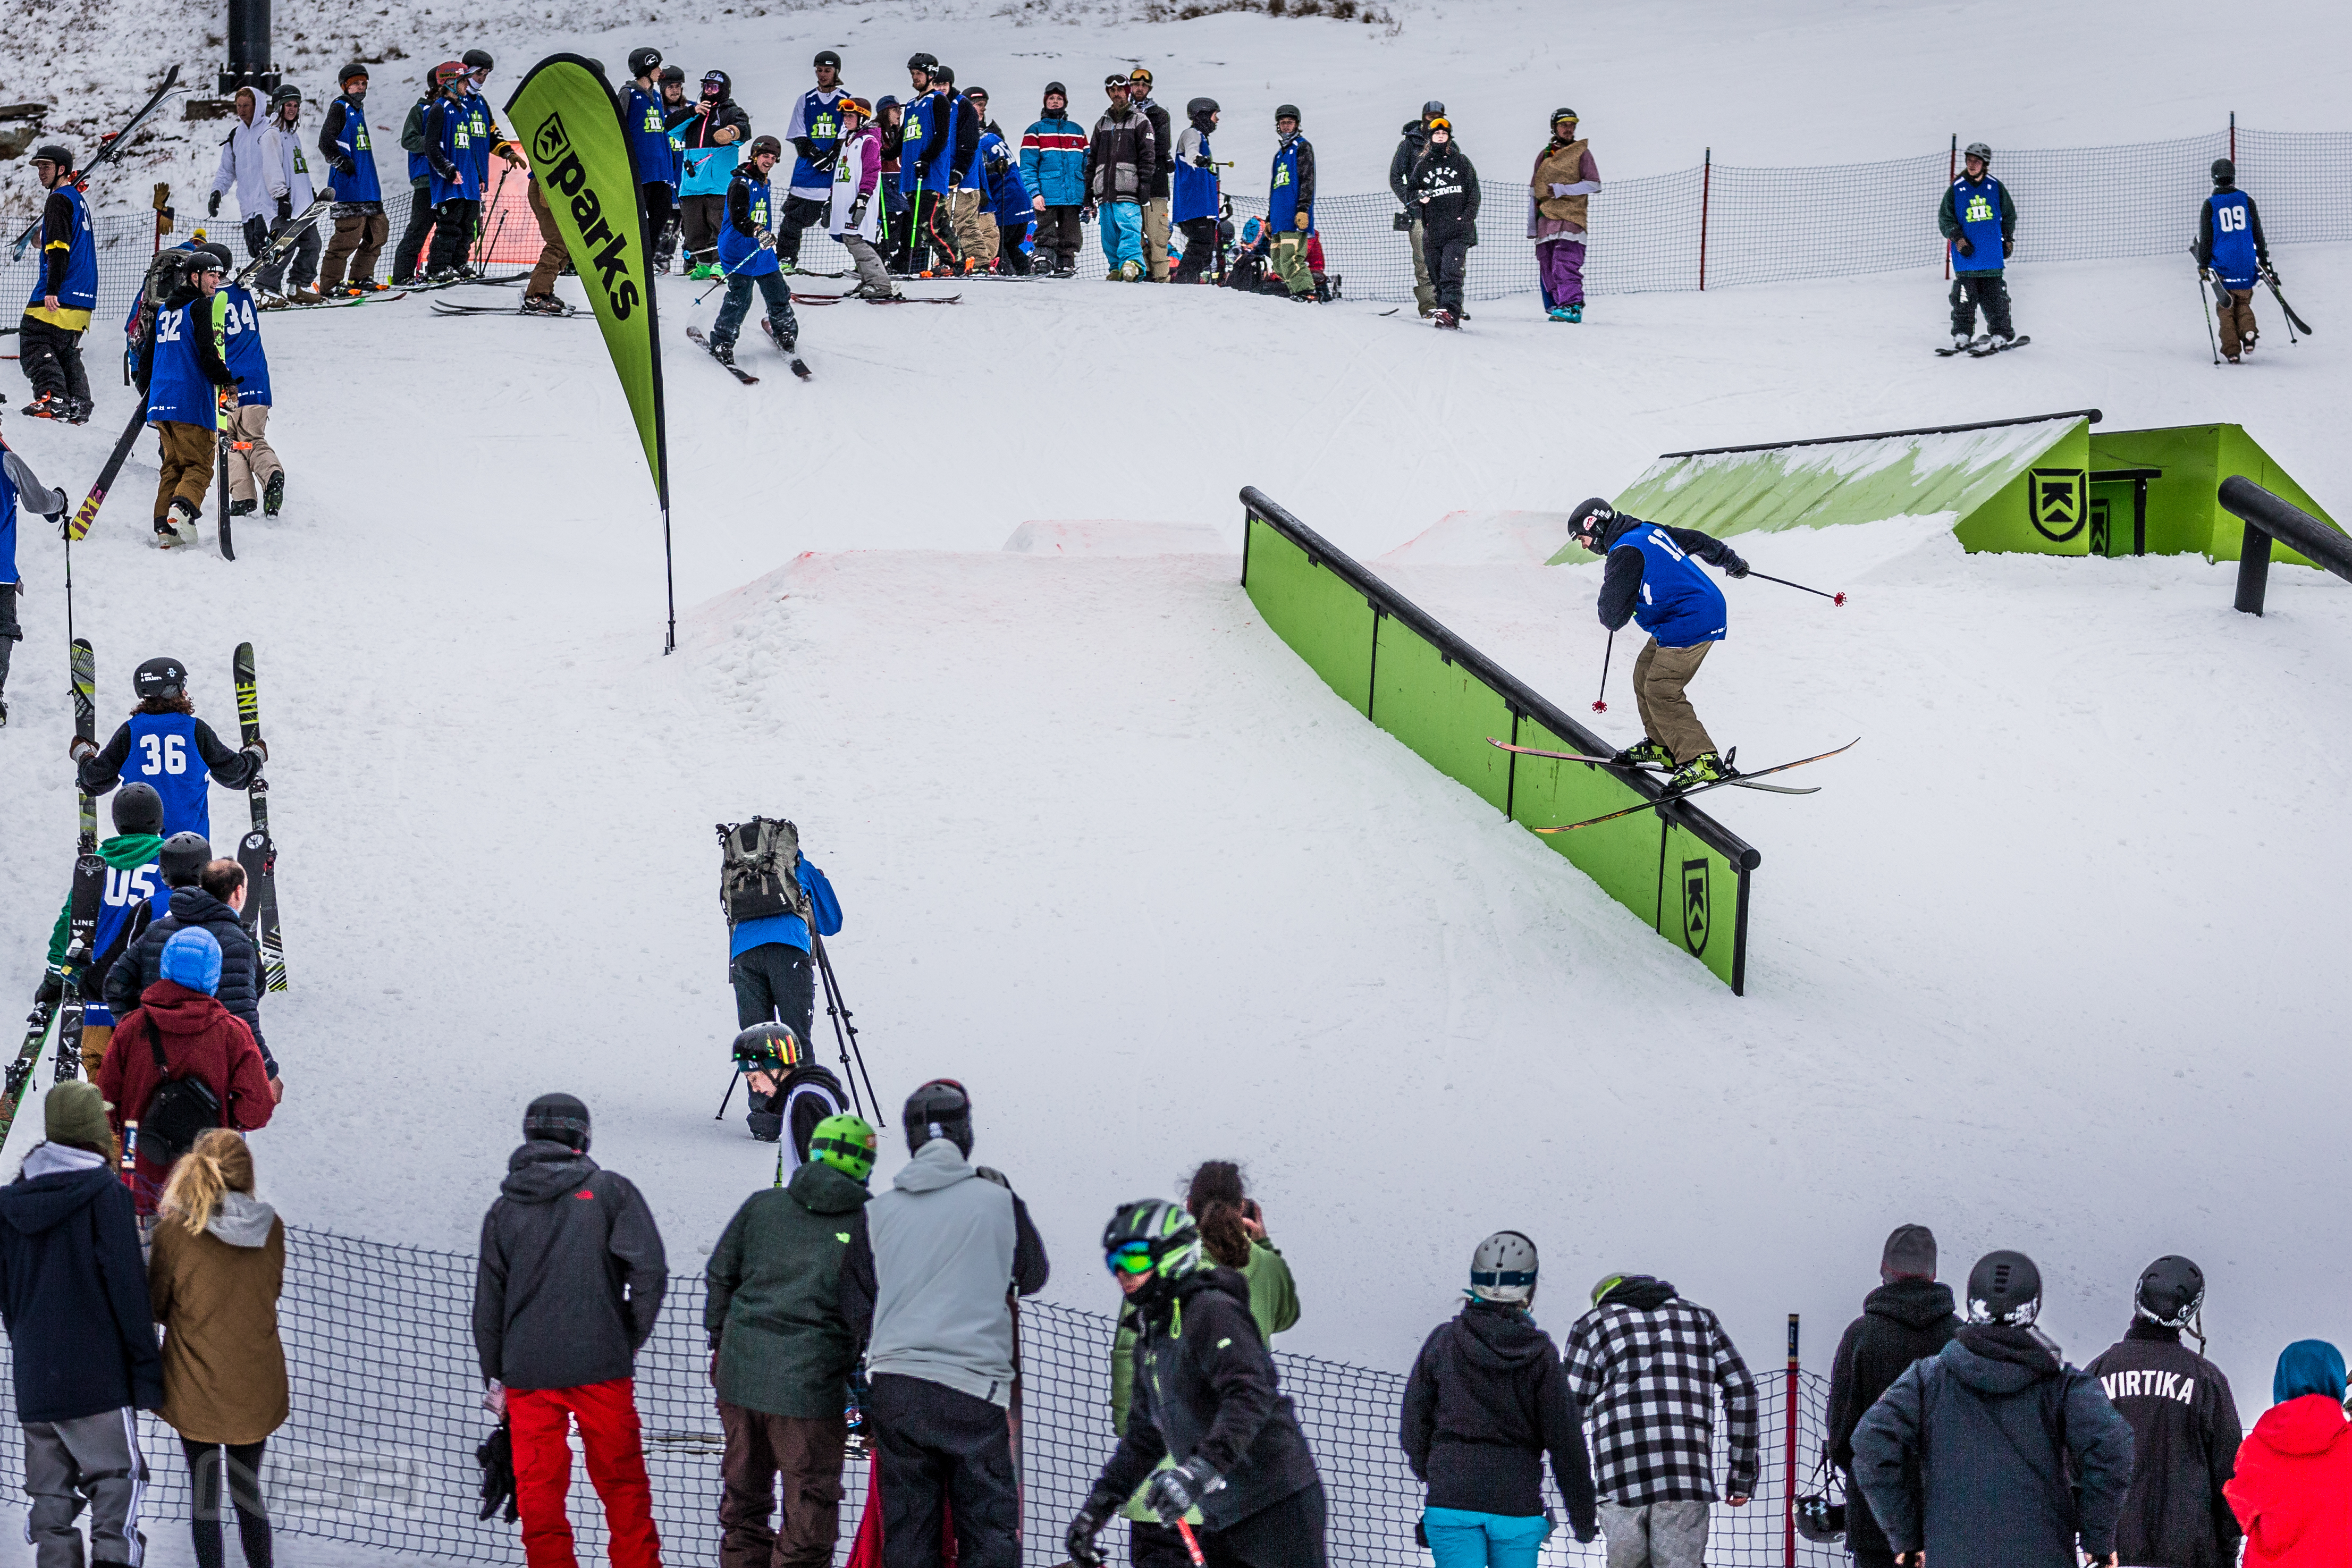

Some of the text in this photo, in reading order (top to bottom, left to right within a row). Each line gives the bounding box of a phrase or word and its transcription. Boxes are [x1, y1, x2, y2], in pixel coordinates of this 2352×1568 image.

[546, 150, 639, 321] parks
[2219, 205, 2246, 232] 09
[157, 309, 183, 343] 32
[225, 300, 256, 335] 34
[236, 681, 259, 726] LINE
[140, 734, 187, 775] 36
[1676, 770, 1706, 787] DALBELLO
[2100, 1370, 2195, 1405] VIRTIKA
